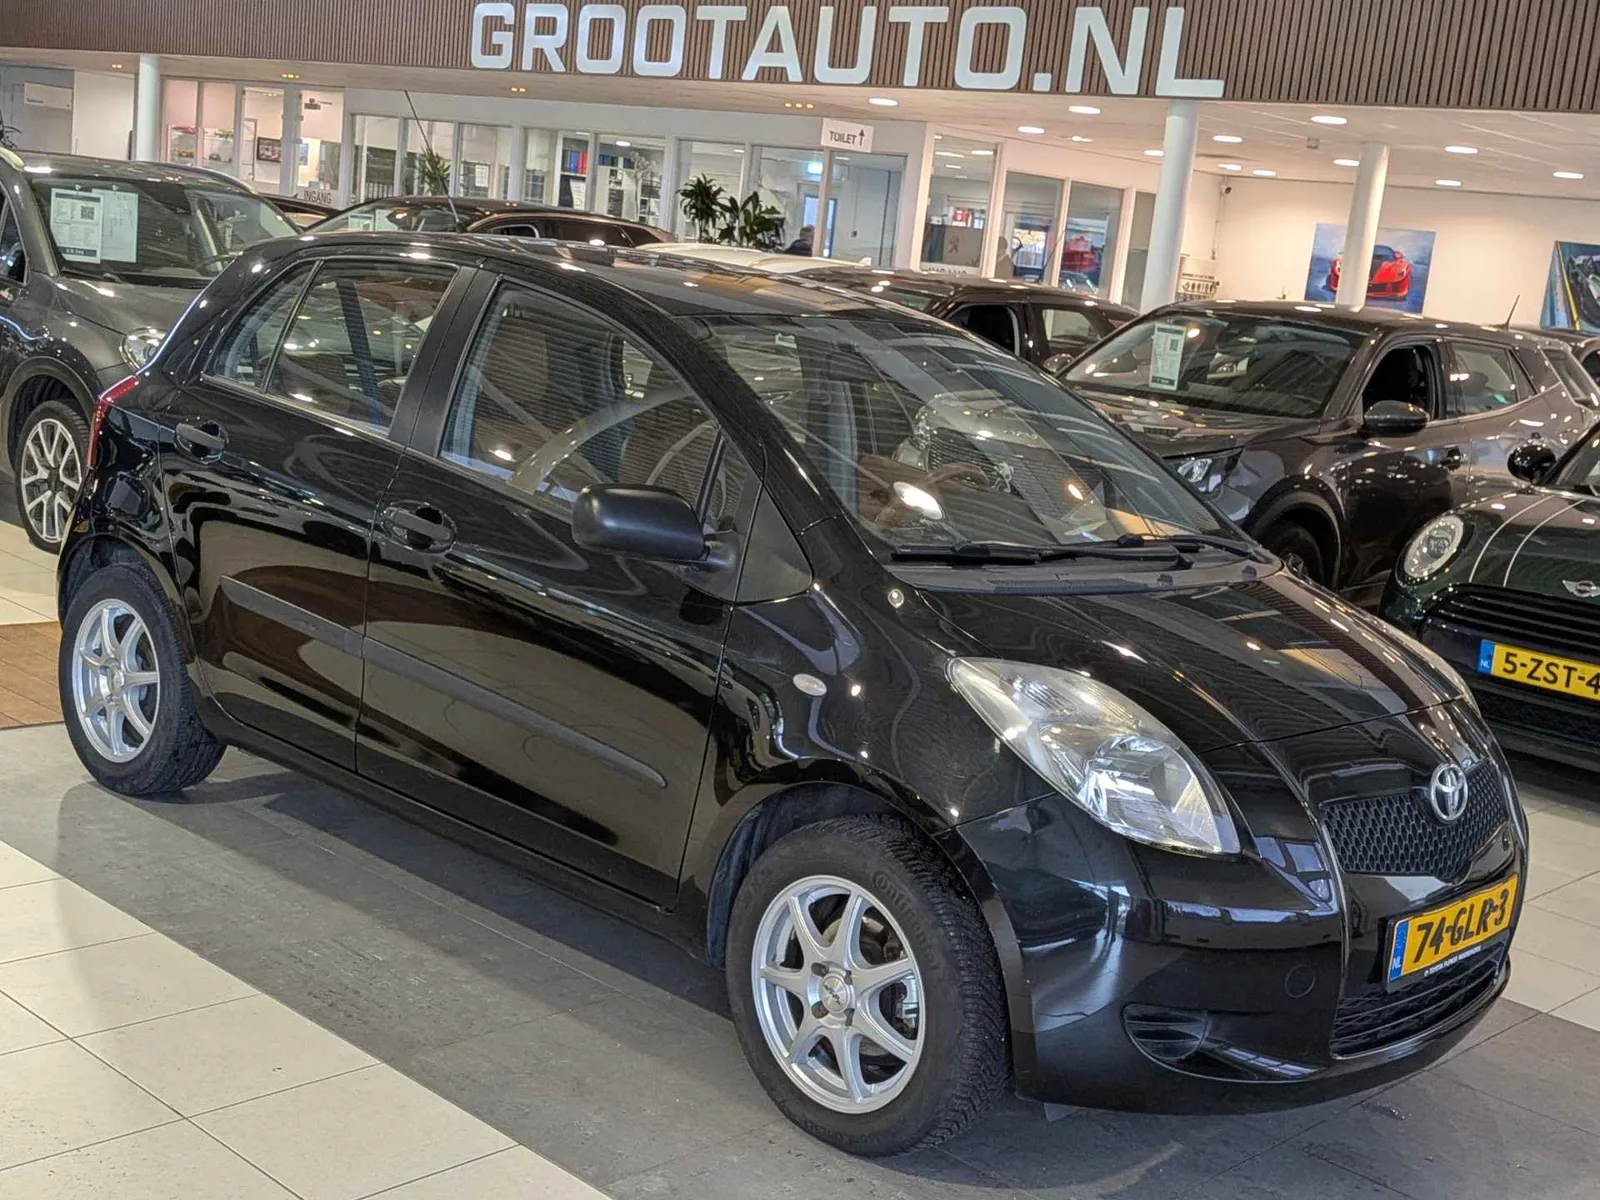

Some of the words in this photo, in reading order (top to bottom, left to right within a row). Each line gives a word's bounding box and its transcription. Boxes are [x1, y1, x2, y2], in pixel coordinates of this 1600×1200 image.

[470, 2, 1225, 98] GROOTAUTO.NL
[829, 130, 858, 145] TOILET
[303, 190, 332, 205] INGANG
[1480, 659, 1490, 669] NL
[1502, 651, 1600, 695] 5-ZST-4
[1413, 888, 1509, 964] 74-GLR-3
[1392, 955, 1402, 971] NL
